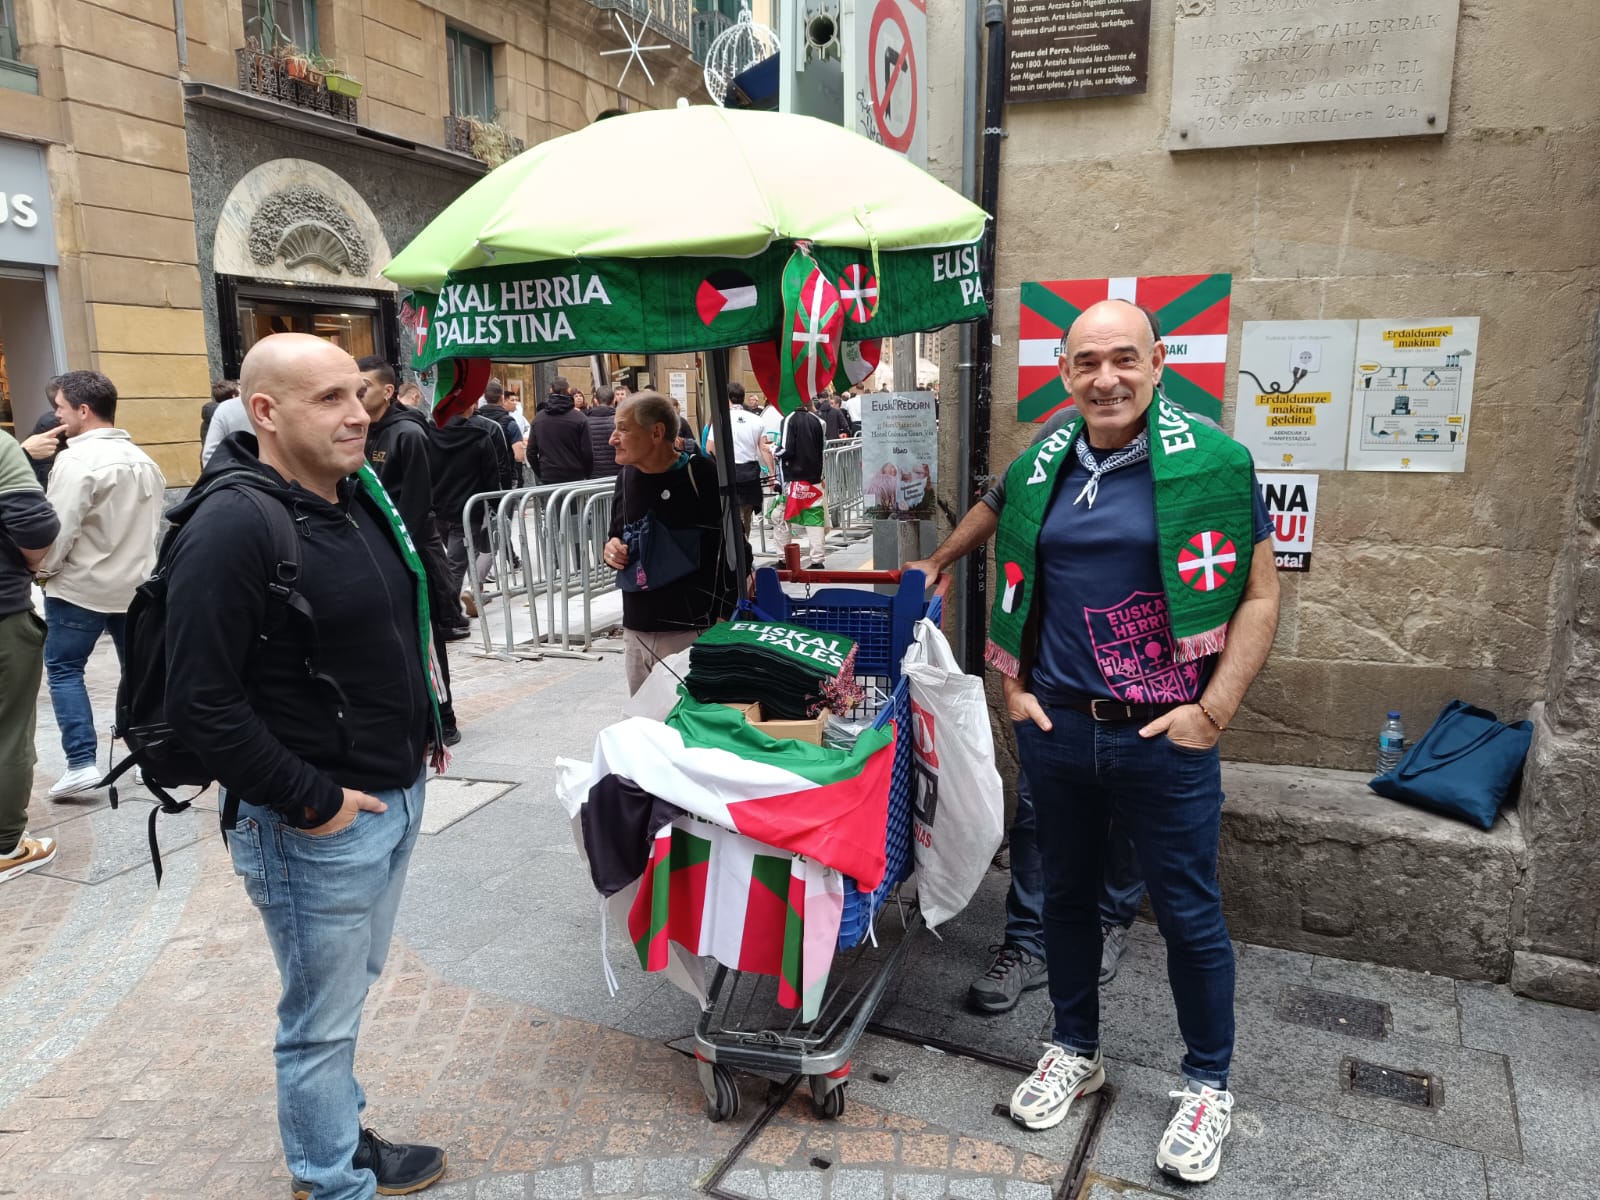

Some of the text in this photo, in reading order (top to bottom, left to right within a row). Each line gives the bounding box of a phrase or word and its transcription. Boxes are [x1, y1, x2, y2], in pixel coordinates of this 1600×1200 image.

[1316, 14, 1441, 38] TAILERRAK
[1010, 61, 1024, 70] Año
[1026, 60, 1043, 69] 1800.
[1128, 51, 1137, 60] de
[1011, 50, 1036, 59] Fuente
[1036, 47, 1048, 57] del
[1049, 47, 1072, 56] Perro.
[1239, 38, 1383, 64] BERRIZTATUA
[1086, 66, 1092, 75] el
[1093, 66, 1107, 74] arte
[1195, 59, 1425, 91] RESTAURADO POR EL
[1072, 79, 1079, 87] la
[1190, 89, 1270, 108] TALLER
[1280, 86, 1306, 103] DE
[500, 274, 613, 311] HERRIA
[434, 311, 576, 350] PALESTINA
[1387, 328, 1449, 339] Erdalduntze
[1398, 339, 1436, 348] makina
[1259, 394, 1327, 405] Erdalduntze
[1272, 405, 1313, 415] makina
[1271, 415, 1312, 427] gelditu!
[1259, 484, 1309, 512] NA
[730, 623, 842, 656] EUSKAL
[757, 634, 844, 667] PALES
